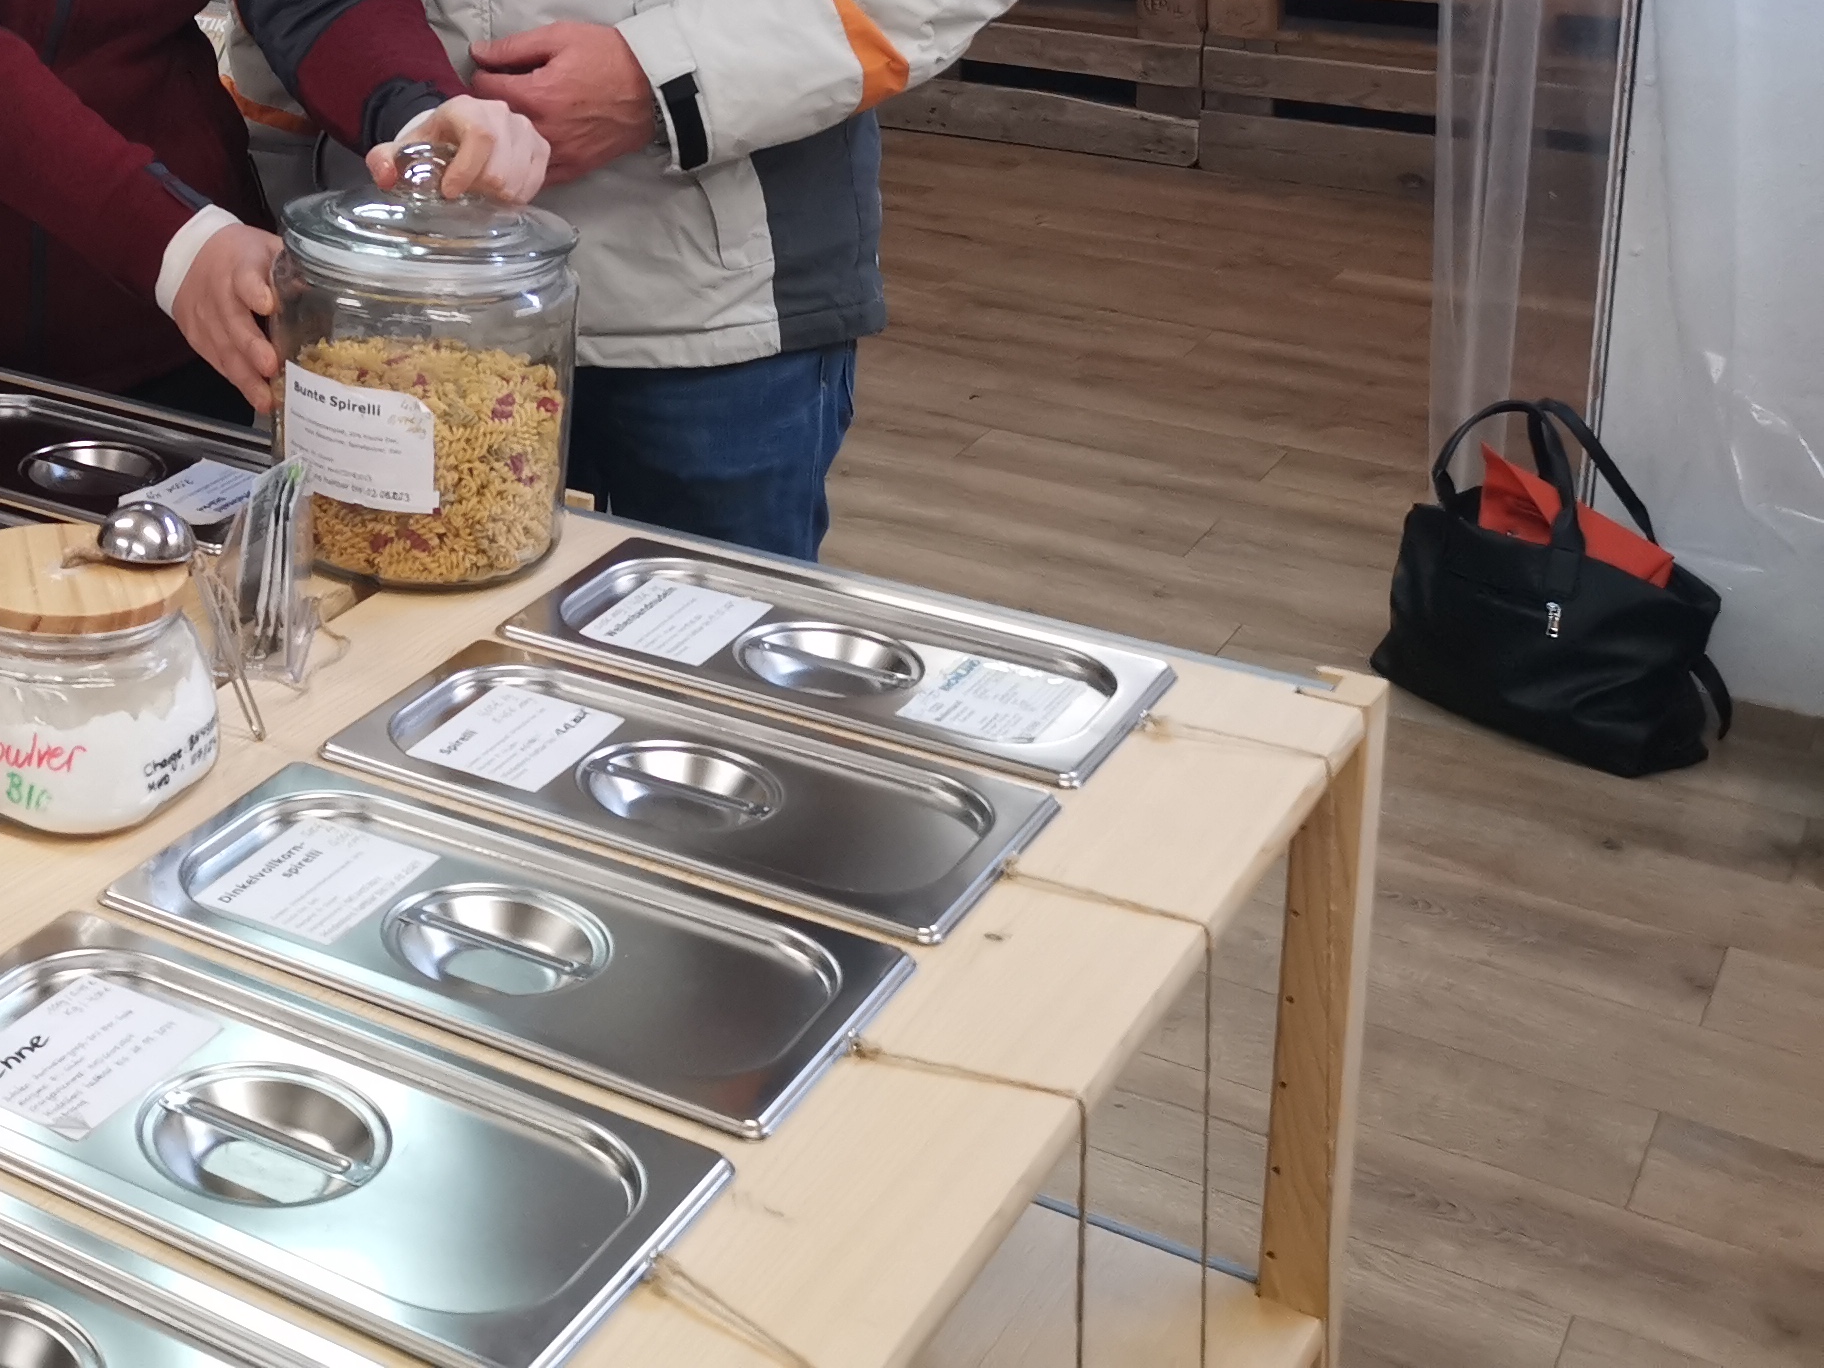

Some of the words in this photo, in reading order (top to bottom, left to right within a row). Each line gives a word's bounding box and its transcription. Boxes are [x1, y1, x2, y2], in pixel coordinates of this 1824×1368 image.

[293, 380, 326, 404] Bunte
[329, 395, 382, 417] Spirelli
[438, 727, 479, 756] Spirelli
[217, 840, 306, 905] Dinkelvollkorn-
[281, 848, 325, 880] spirelli
